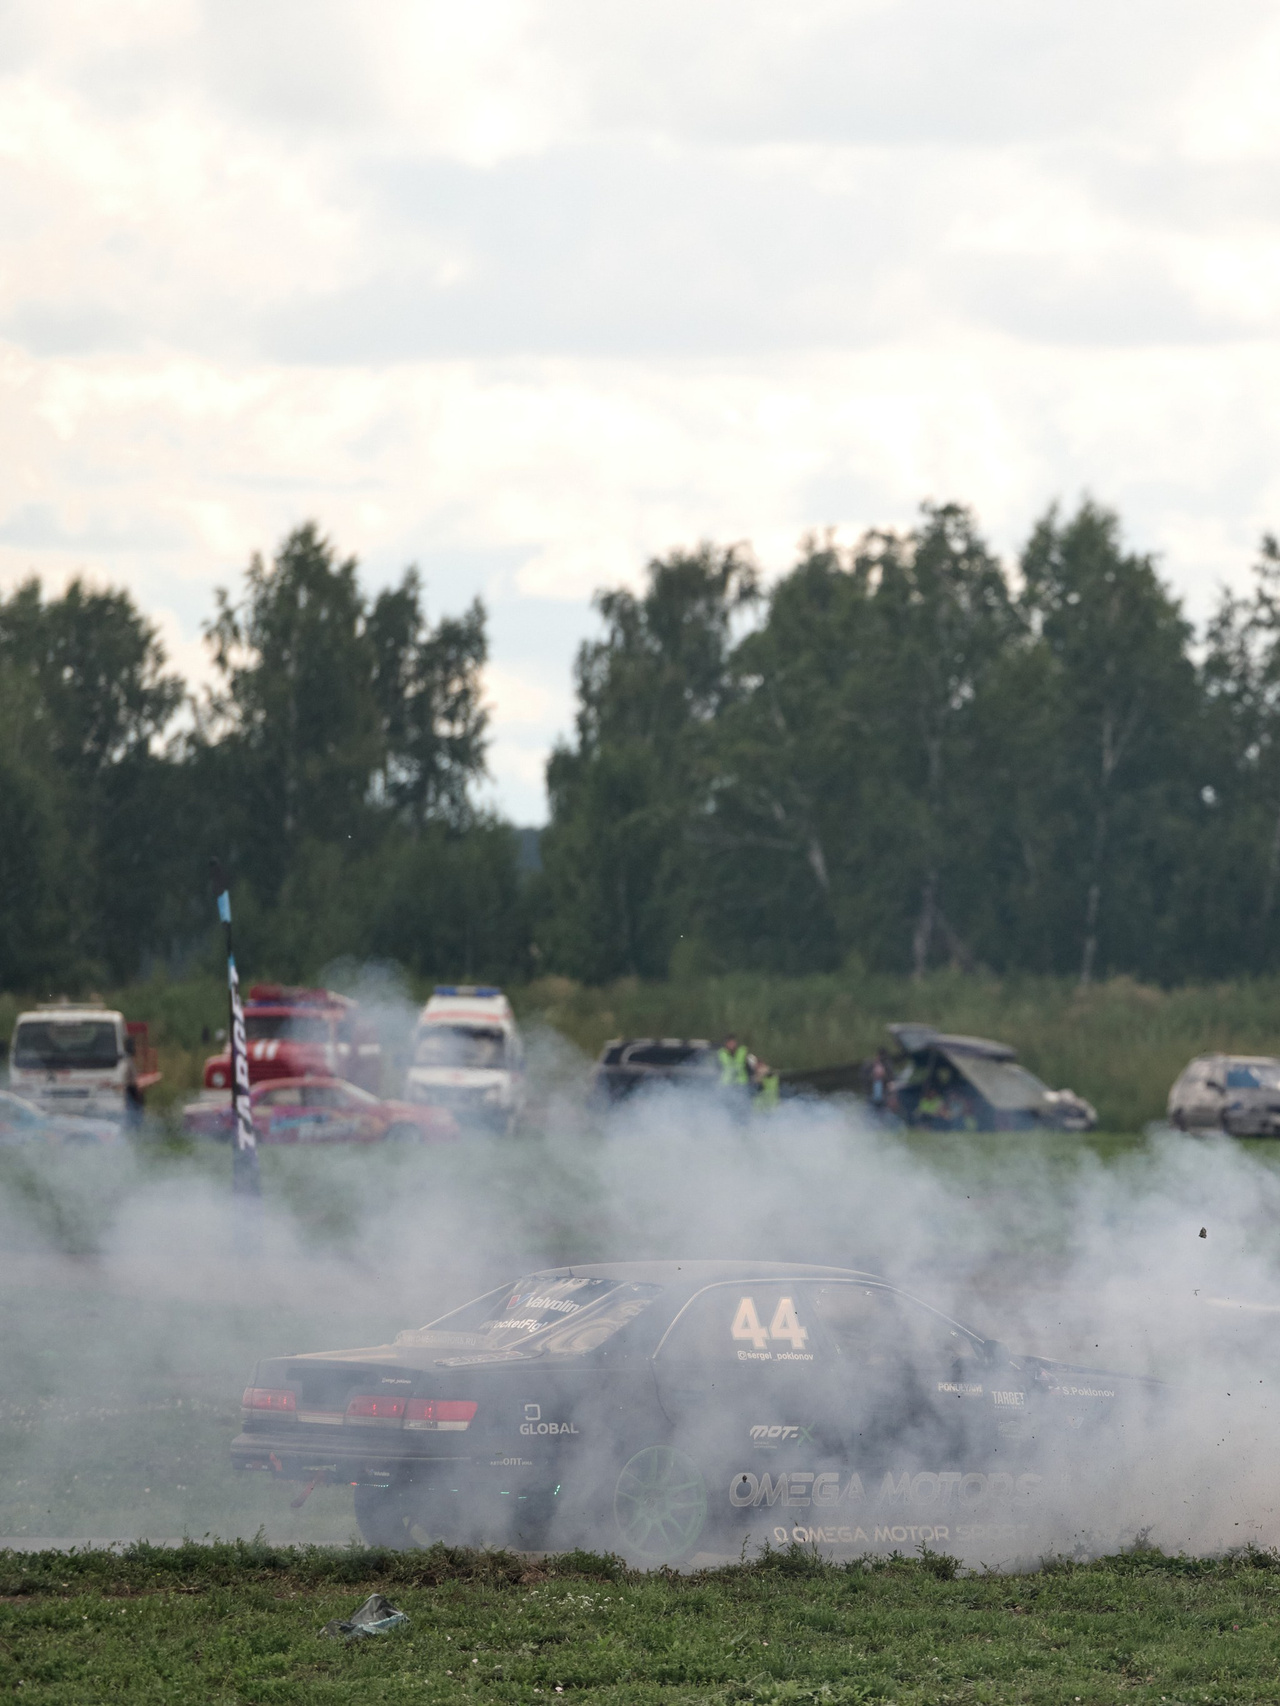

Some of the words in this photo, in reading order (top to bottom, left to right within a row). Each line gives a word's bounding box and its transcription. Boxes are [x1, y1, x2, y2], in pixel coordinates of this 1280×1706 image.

[525, 1296, 581, 1313] Valvolin
[730, 1296, 809, 1350] 44
[991, 1391, 1025, 1406] TARGET
[1062, 1386, 1115, 1398] S.Poklonov
[519, 1423, 580, 1435] GLOBAL
[729, 1472, 867, 1507] OMEGA
[875, 1472, 1044, 1507] MOTORS
[792, 1526, 867, 1543] OMEGA
[874, 1526, 950, 1543] MOTOR
